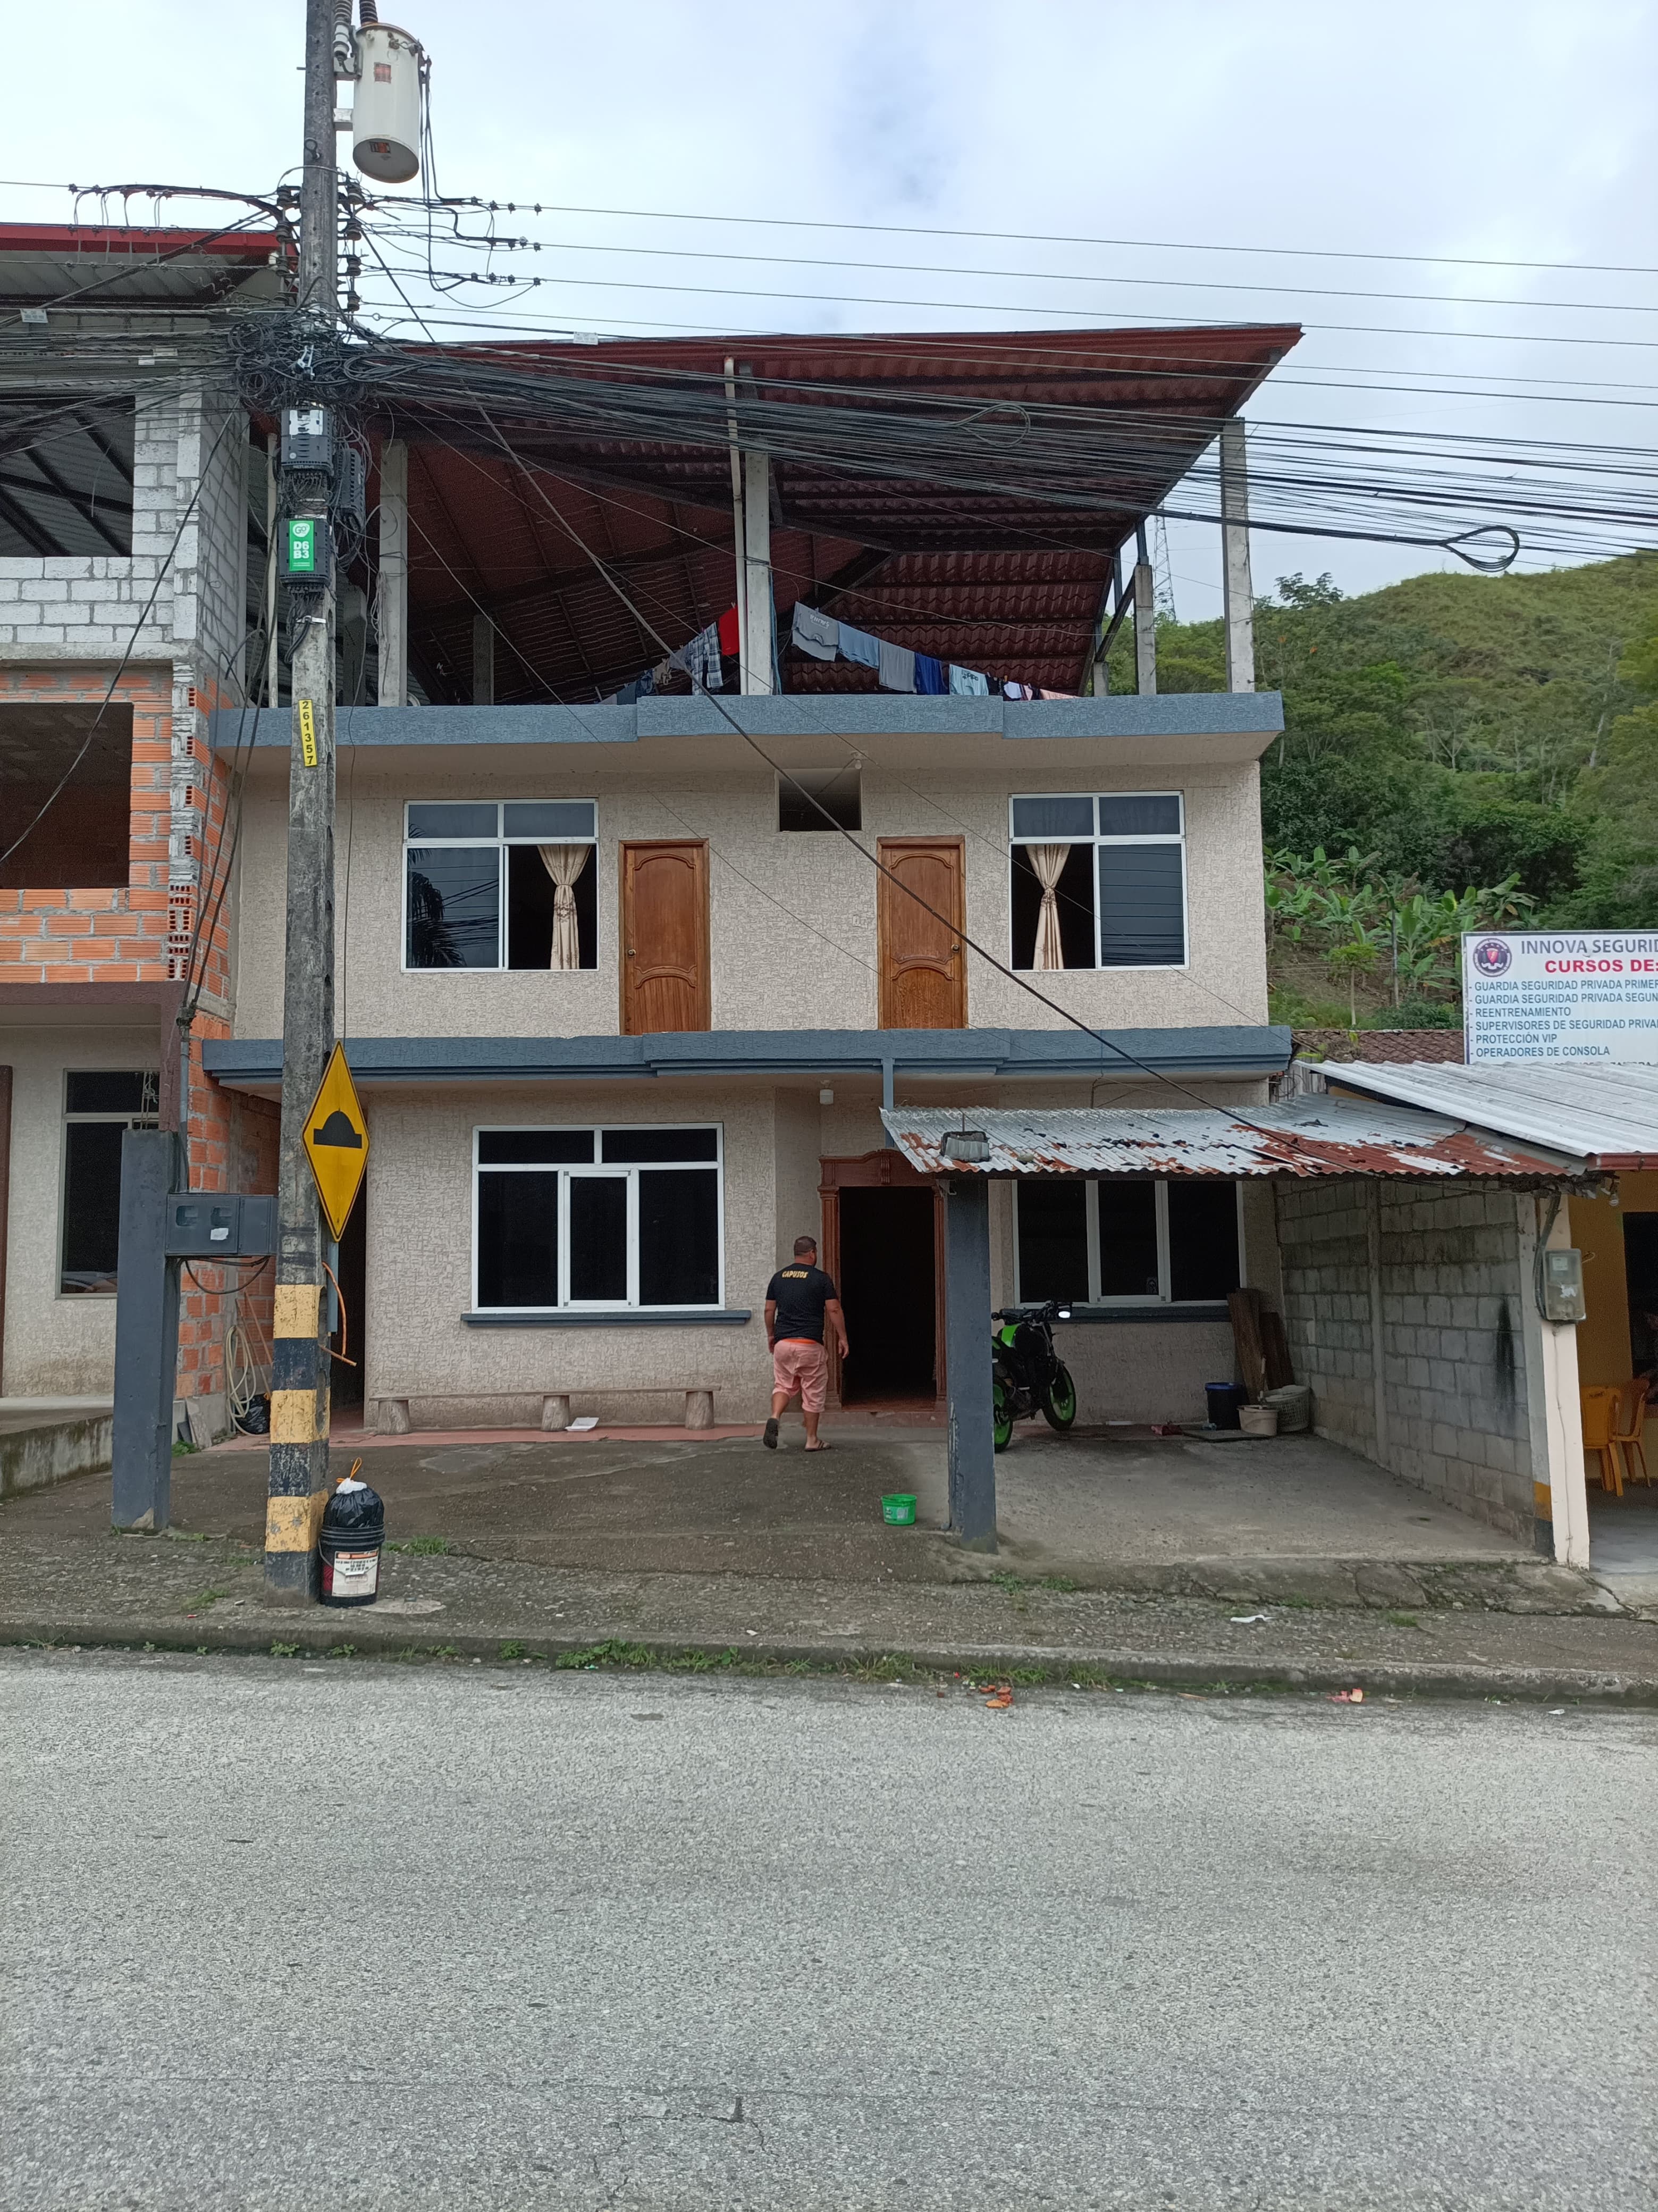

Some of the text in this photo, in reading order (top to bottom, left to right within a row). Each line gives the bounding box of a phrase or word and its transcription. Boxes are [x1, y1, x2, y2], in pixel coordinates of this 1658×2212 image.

[293, 541, 309, 550] D6
[293, 550, 309, 559] B3
[302, 701, 314, 765] 261357
[1522, 940, 1587, 954] INNOVA
[1545, 960, 1623, 973] CURSOS
[1475, 982, 1519, 991] GUARDIA
[1521, 981, 1577, 990] SEGURIDAD
[1581, 980, 1622, 989] PRIVADA
[1475, 995, 1519, 1004] GUARDIA
[1522, 994, 1578, 1003] SEGURIDAD
[1581, 993, 1622, 1002] PRIVADA
[1476, 1007, 1571, 1017] REENTRENAMIENTO
[1476, 1019, 1658, 1030] SUPERVISORES DE SEGURIDAD PRIVA
[1476, 1032, 1557, 1043] PROTECCIÓN VIP
[1476, 1046, 1610, 1057] OPERADORES DE CONSOLA
